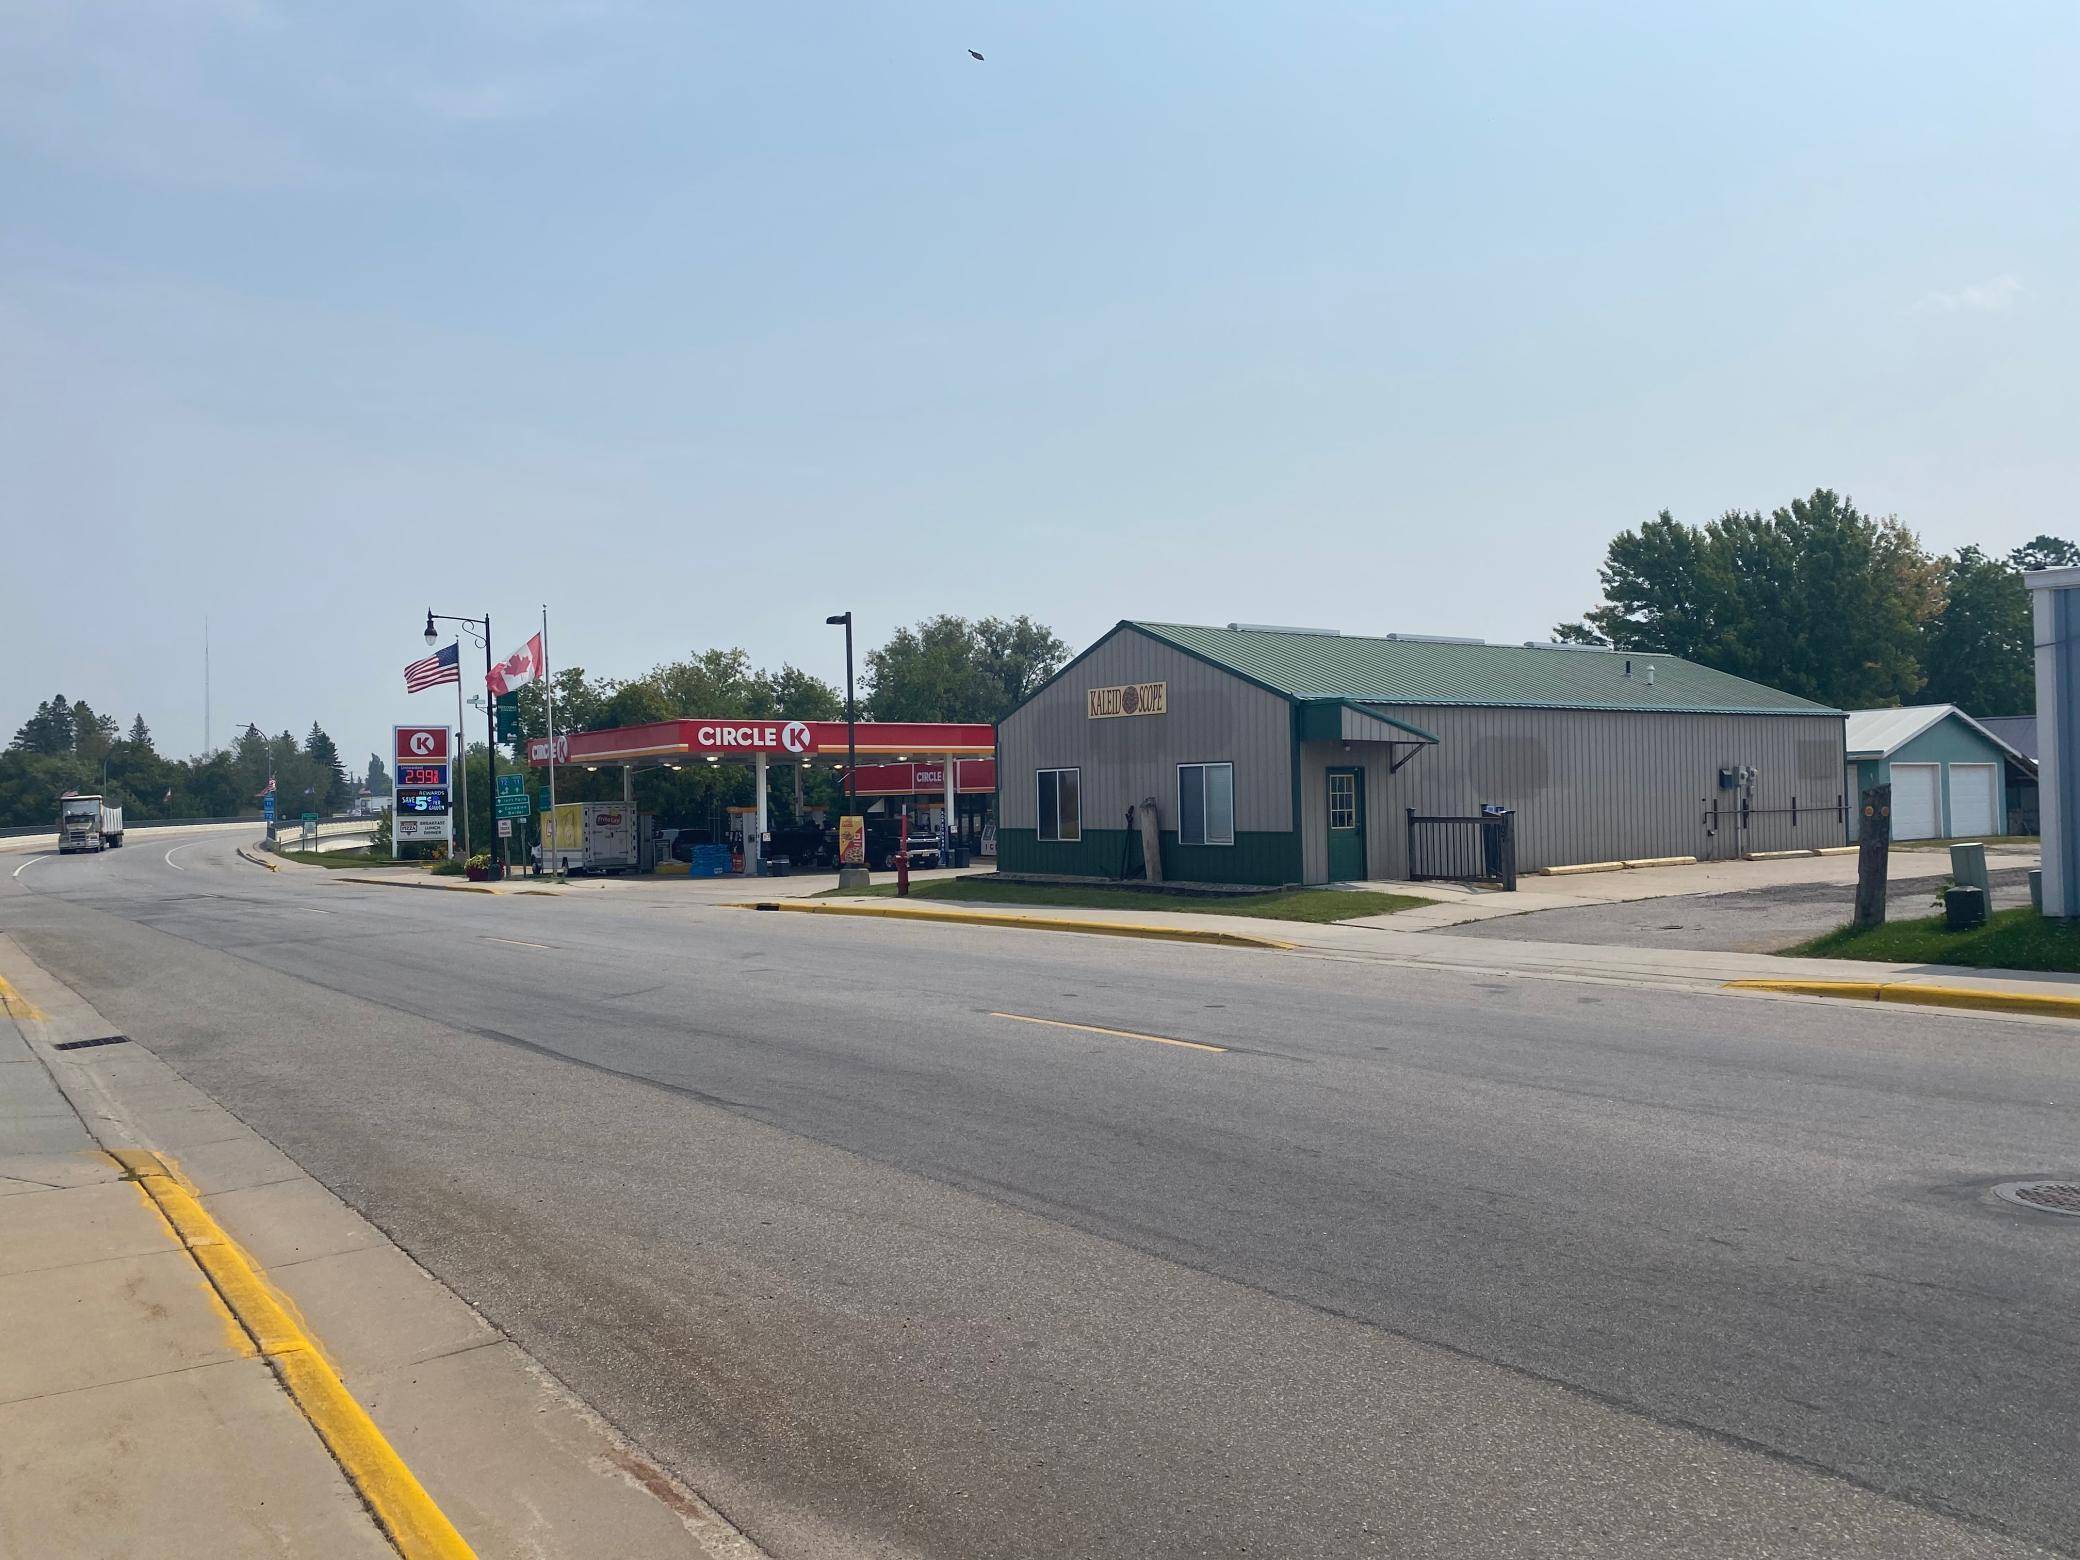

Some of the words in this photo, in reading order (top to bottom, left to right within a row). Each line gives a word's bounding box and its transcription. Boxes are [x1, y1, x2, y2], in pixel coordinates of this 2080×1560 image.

[698, 726, 777, 746] CIRCLE
[789, 727, 809, 751] K
[532, 743, 557, 760] CIRCE
[916, 772, 942, 783] CIRCLE
[402, 796, 416, 804] SAVE
